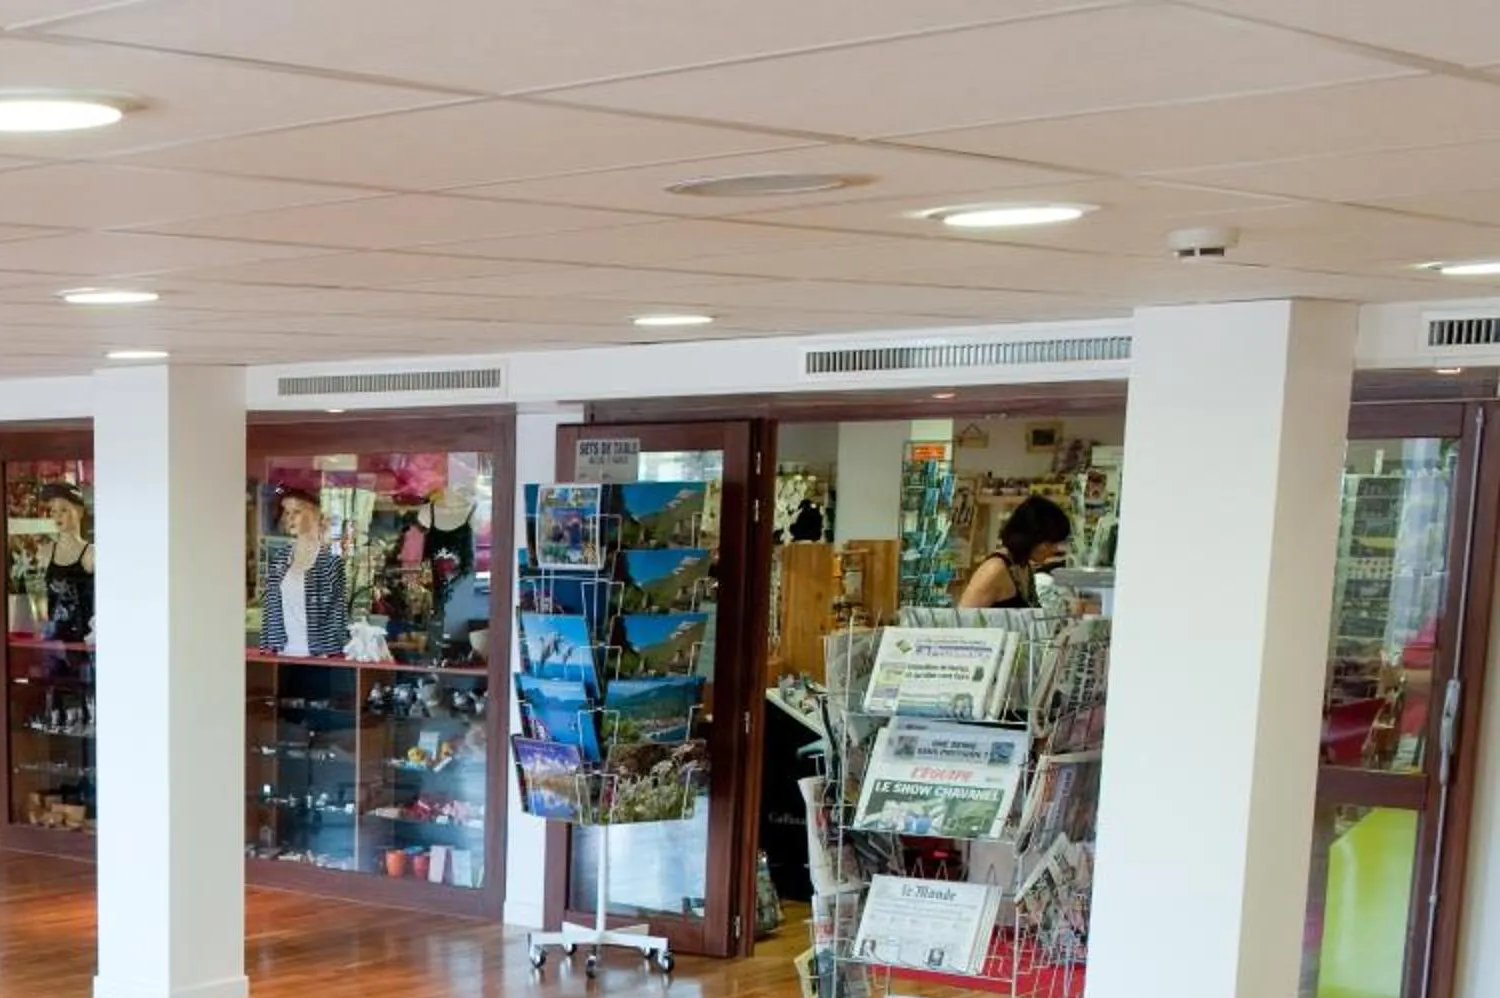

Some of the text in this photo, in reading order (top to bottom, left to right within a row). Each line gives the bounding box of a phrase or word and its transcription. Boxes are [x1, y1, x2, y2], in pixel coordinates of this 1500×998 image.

[875, 780, 892, 793] LE
[893, 782, 934, 796] SHOW
[916, 885, 957, 901] Monde
